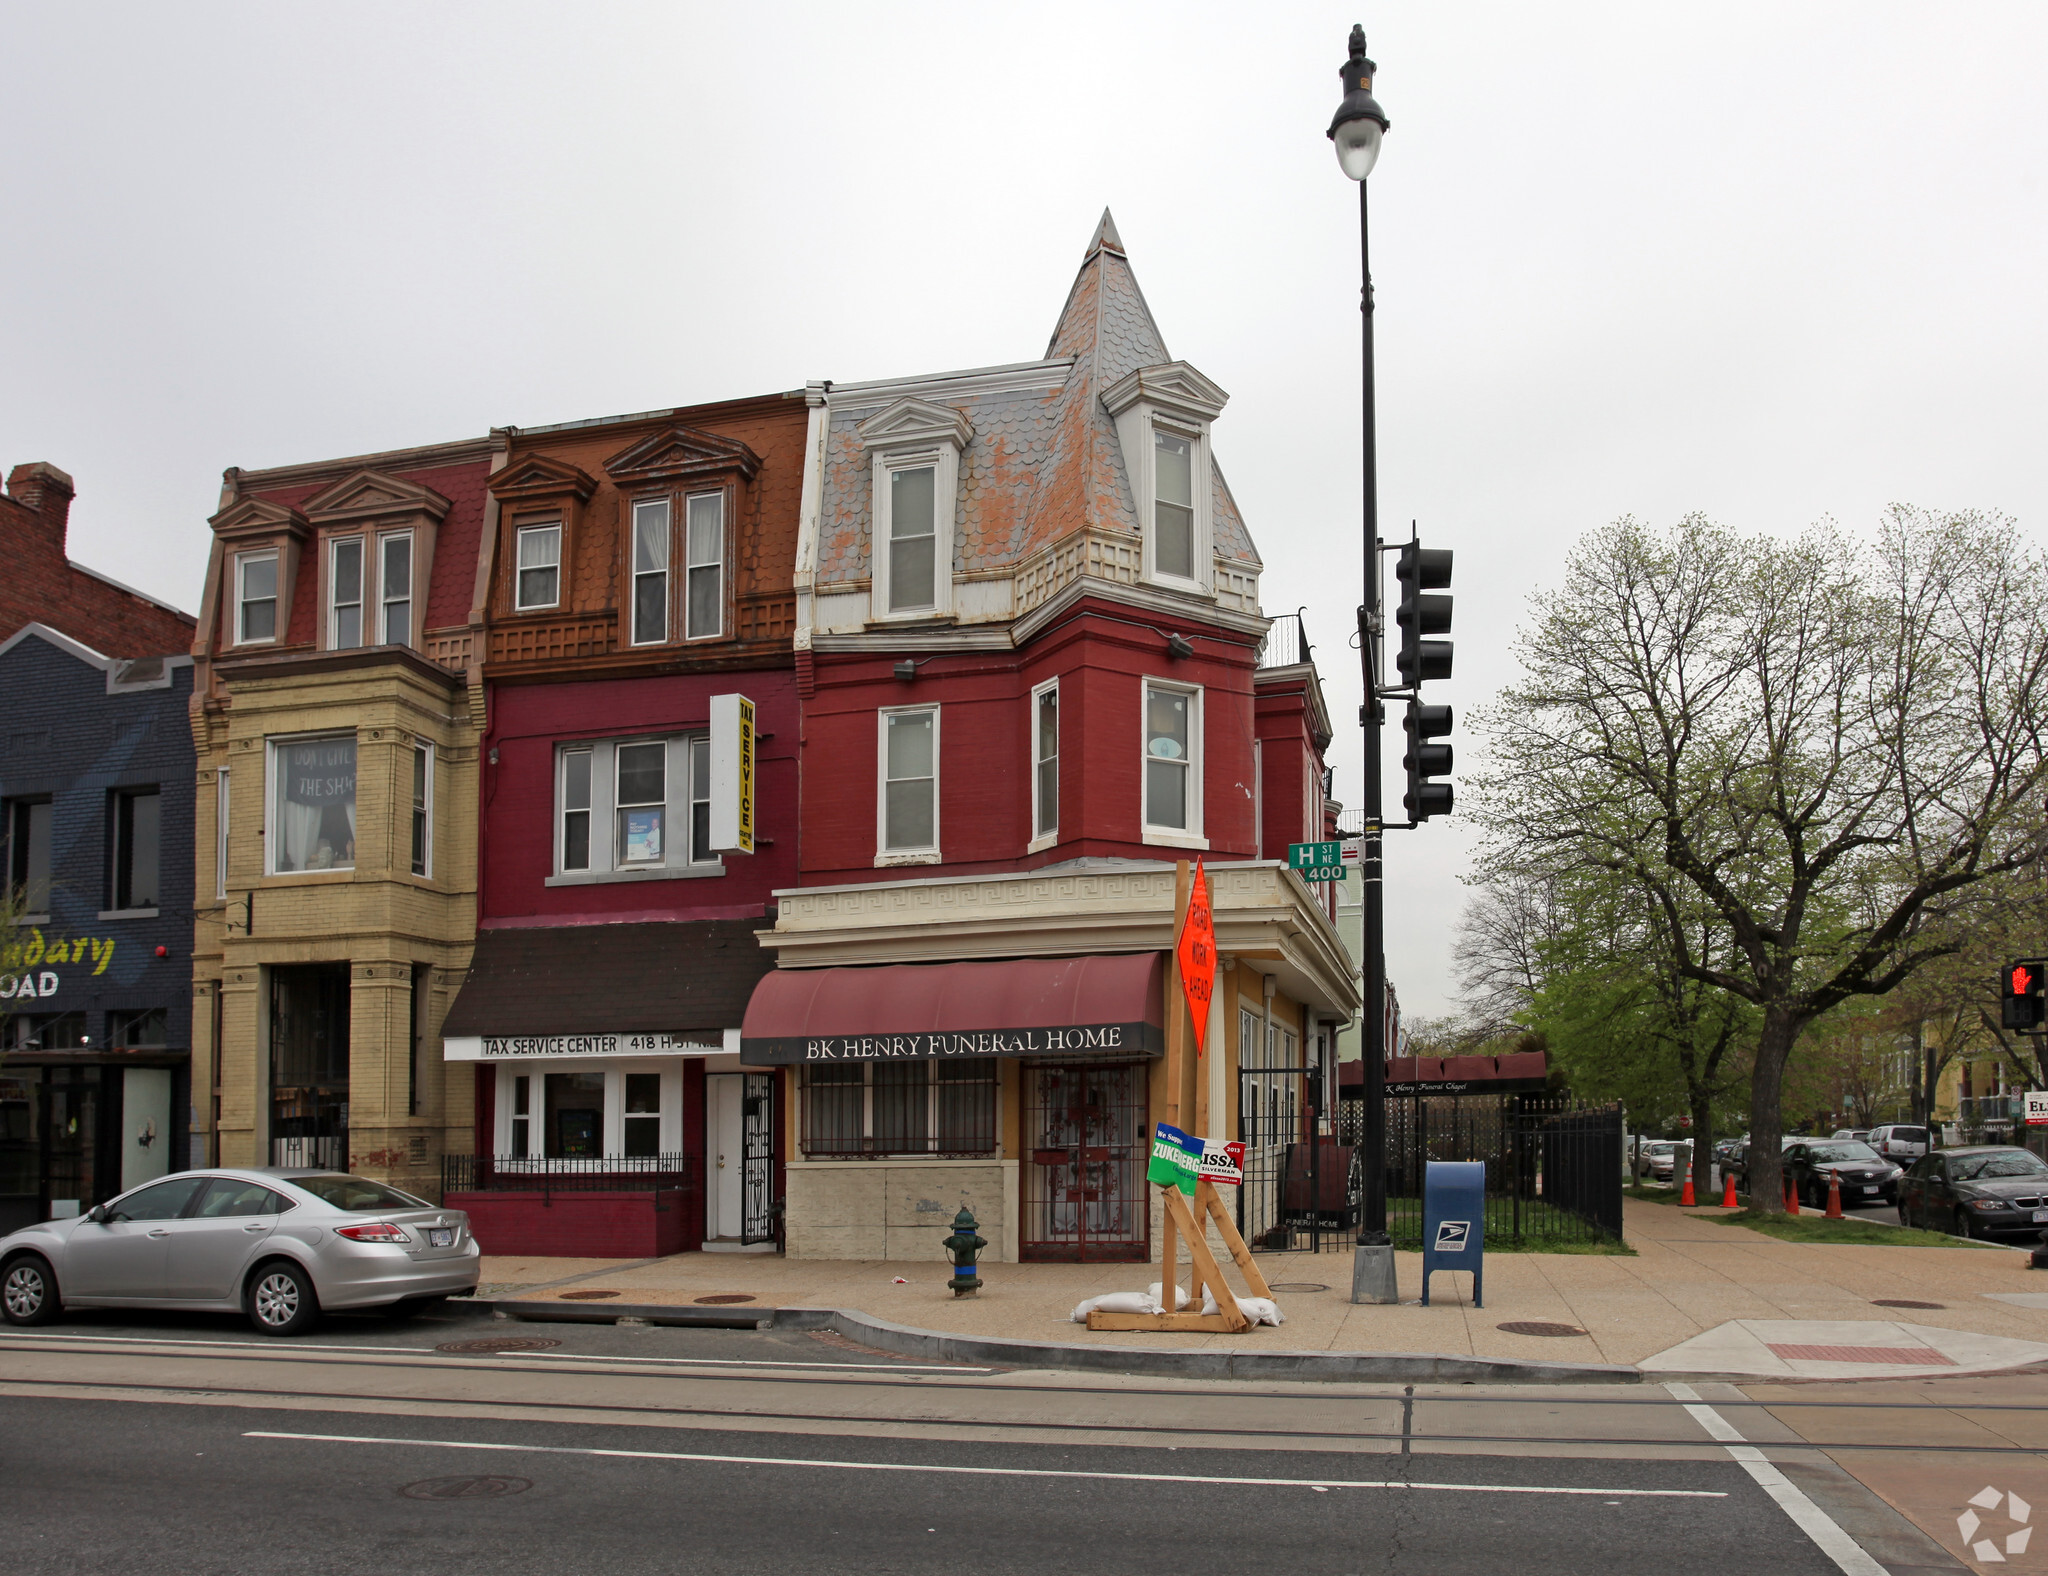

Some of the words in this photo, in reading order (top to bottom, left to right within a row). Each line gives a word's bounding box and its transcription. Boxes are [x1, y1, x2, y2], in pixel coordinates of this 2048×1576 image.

[741, 702, 753, 723] TAX
[742, 724, 750, 827] SERVICE
[300, 777, 323, 797] THE
[1299, 846, 1314, 865] H
[1322, 845, 1333, 854] ST
[1322, 855, 1333, 863] NE
[1308, 866, 1342, 880] 400
[1193, 903, 1208, 931] ROAD
[1192, 941, 1207, 967] WORK
[1190, 976, 1208, 1001] AHEAD
[483, 1039, 510, 1055] TAX
[513, 1037, 564, 1054] SERVICE
[567, 1036, 617, 1053] CENTER
[630, 1036, 656, 1050] 418
[661, 1036, 671, 1049] H
[806, 1040, 836, 1060] BK
[842, 1036, 921, 1058] HENRY
[927, 1031, 1040, 1054] FUNERAL
[1046, 1027, 1122, 1049] HOME
[1395, 1083, 1415, 1093] Henry
[1418, 1083, 1443, 1091] Funeral
[1445, 1082, 1468, 1092] Chapel
[2029, 1101, 2048, 1112] EL
[1157, 1130, 1167, 1138] We
[1200, 1153, 1239, 1168] ISSA
[1201, 1166, 1236, 1174] SILVERMAN
[1318, 1220, 1338, 1228] HOME
